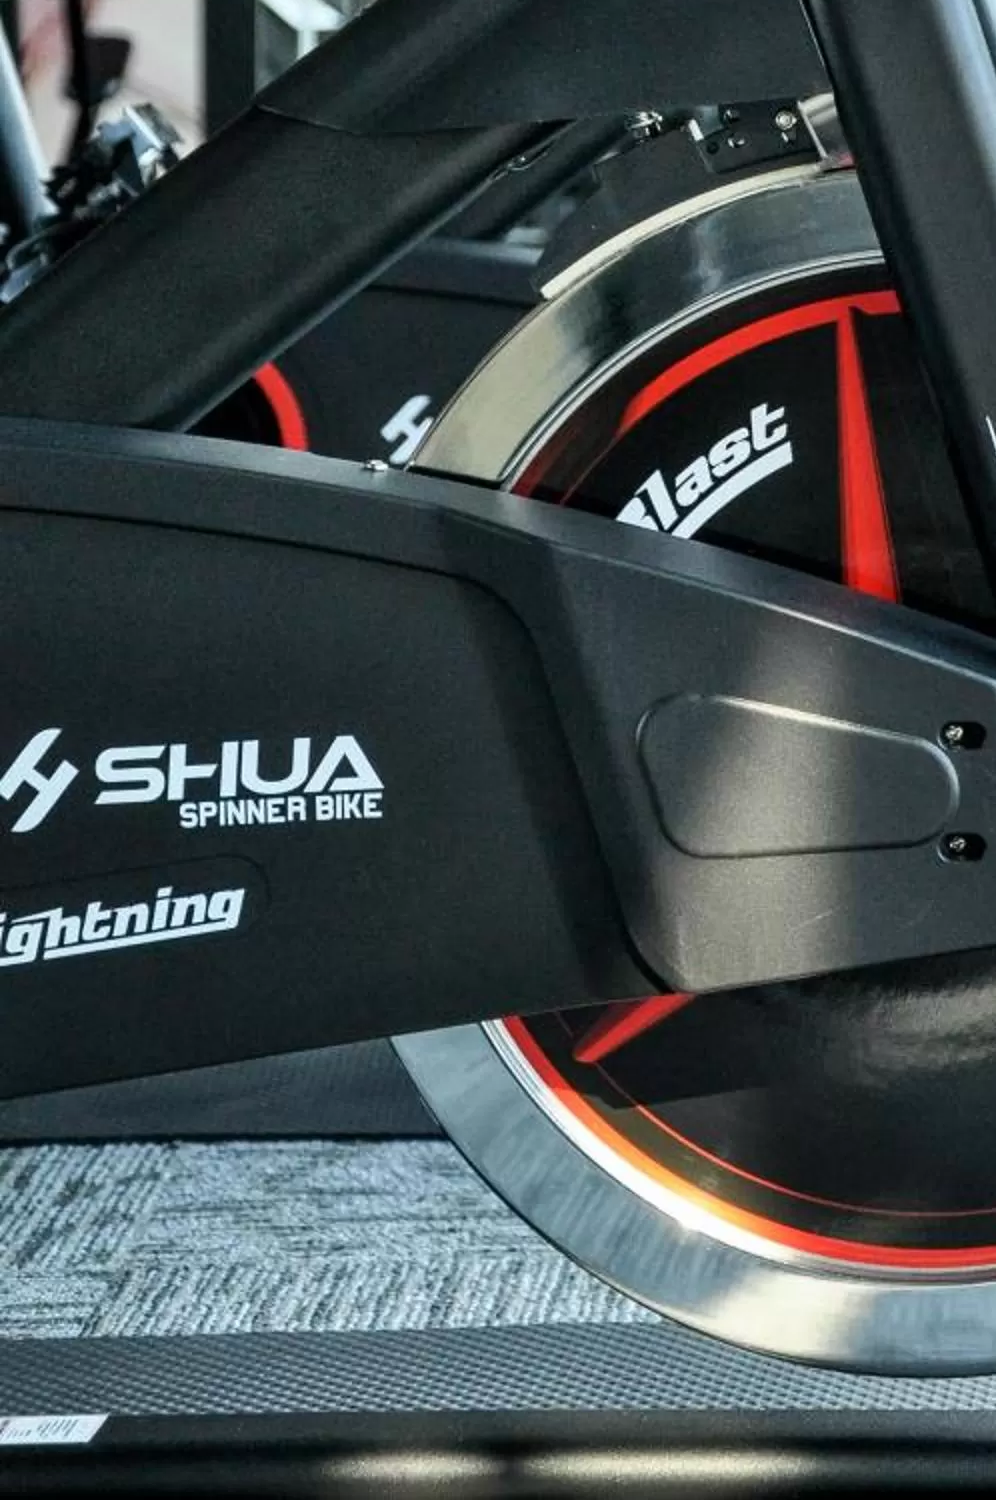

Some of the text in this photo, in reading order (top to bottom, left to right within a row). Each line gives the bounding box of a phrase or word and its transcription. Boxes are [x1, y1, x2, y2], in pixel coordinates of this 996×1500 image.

[94, 735, 385, 805] SHUA
[179, 792, 384, 830] SPINNER BIKE
